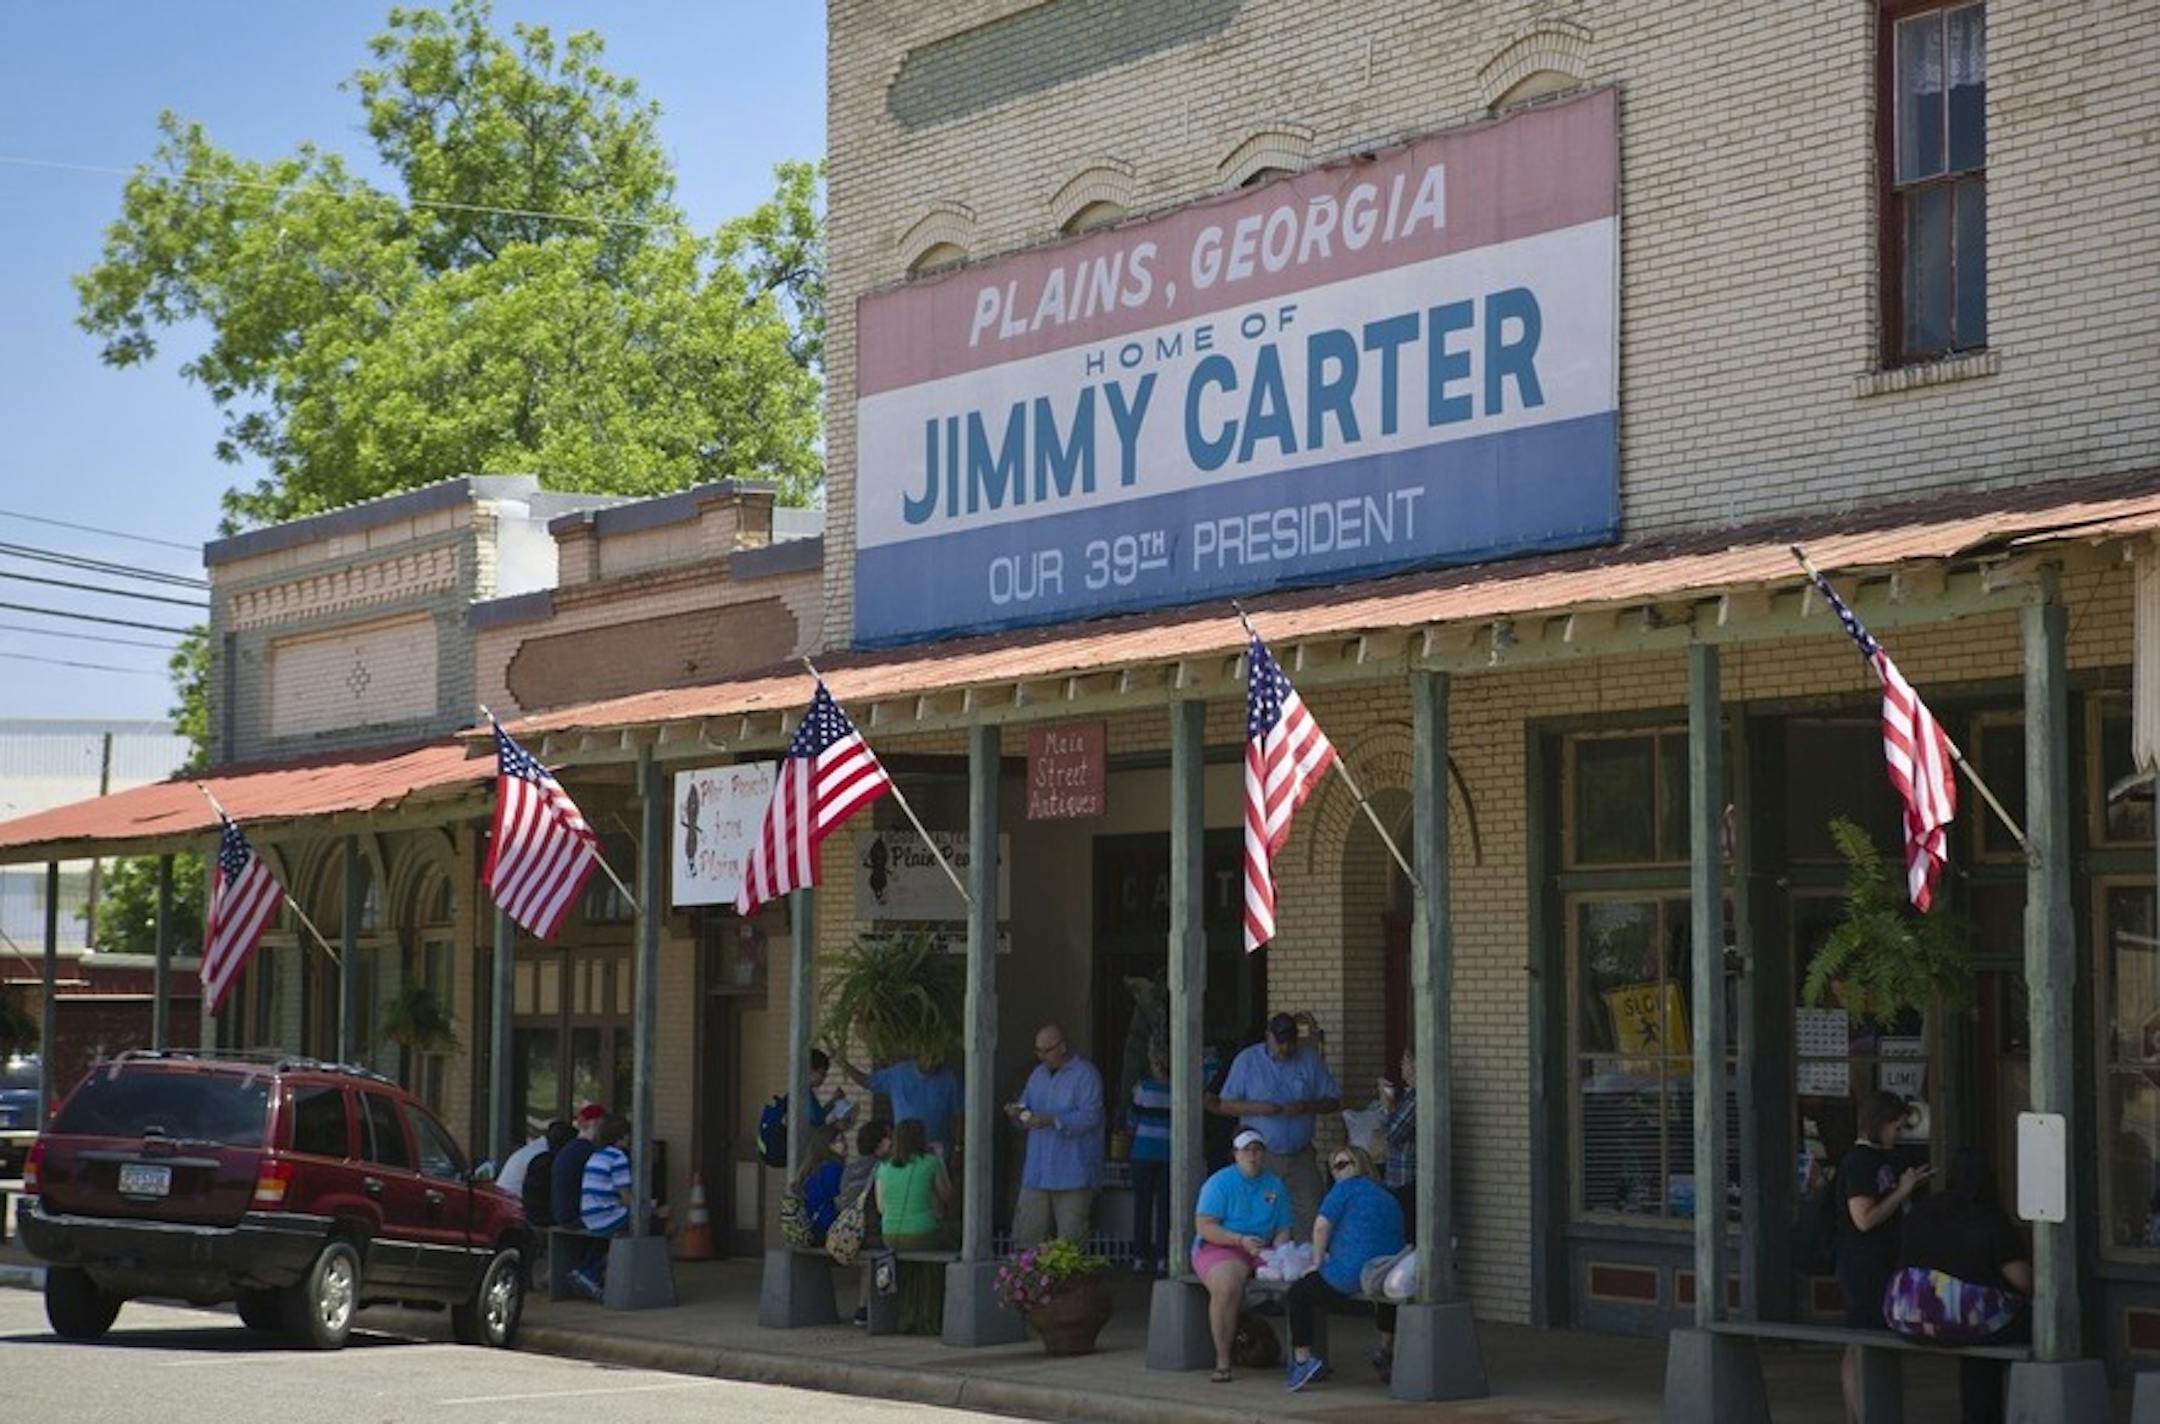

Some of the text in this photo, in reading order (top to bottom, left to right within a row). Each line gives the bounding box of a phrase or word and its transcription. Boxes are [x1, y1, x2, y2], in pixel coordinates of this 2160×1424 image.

[969, 163, 1446, 347] PLAINS, GEORGIA
[1086, 305, 1299, 375] HOME OF
[902, 286, 1544, 525] JIMMY CARTER
[988, 550, 1063, 605] OUR
[1193, 487, 1425, 572] PRESIDENT
[1045, 732, 1084, 755] Main
[1034, 756, 1088, 788] Street
[1028, 789, 1096, 819] Antiques
[891, 846, 936, 868] Plain
